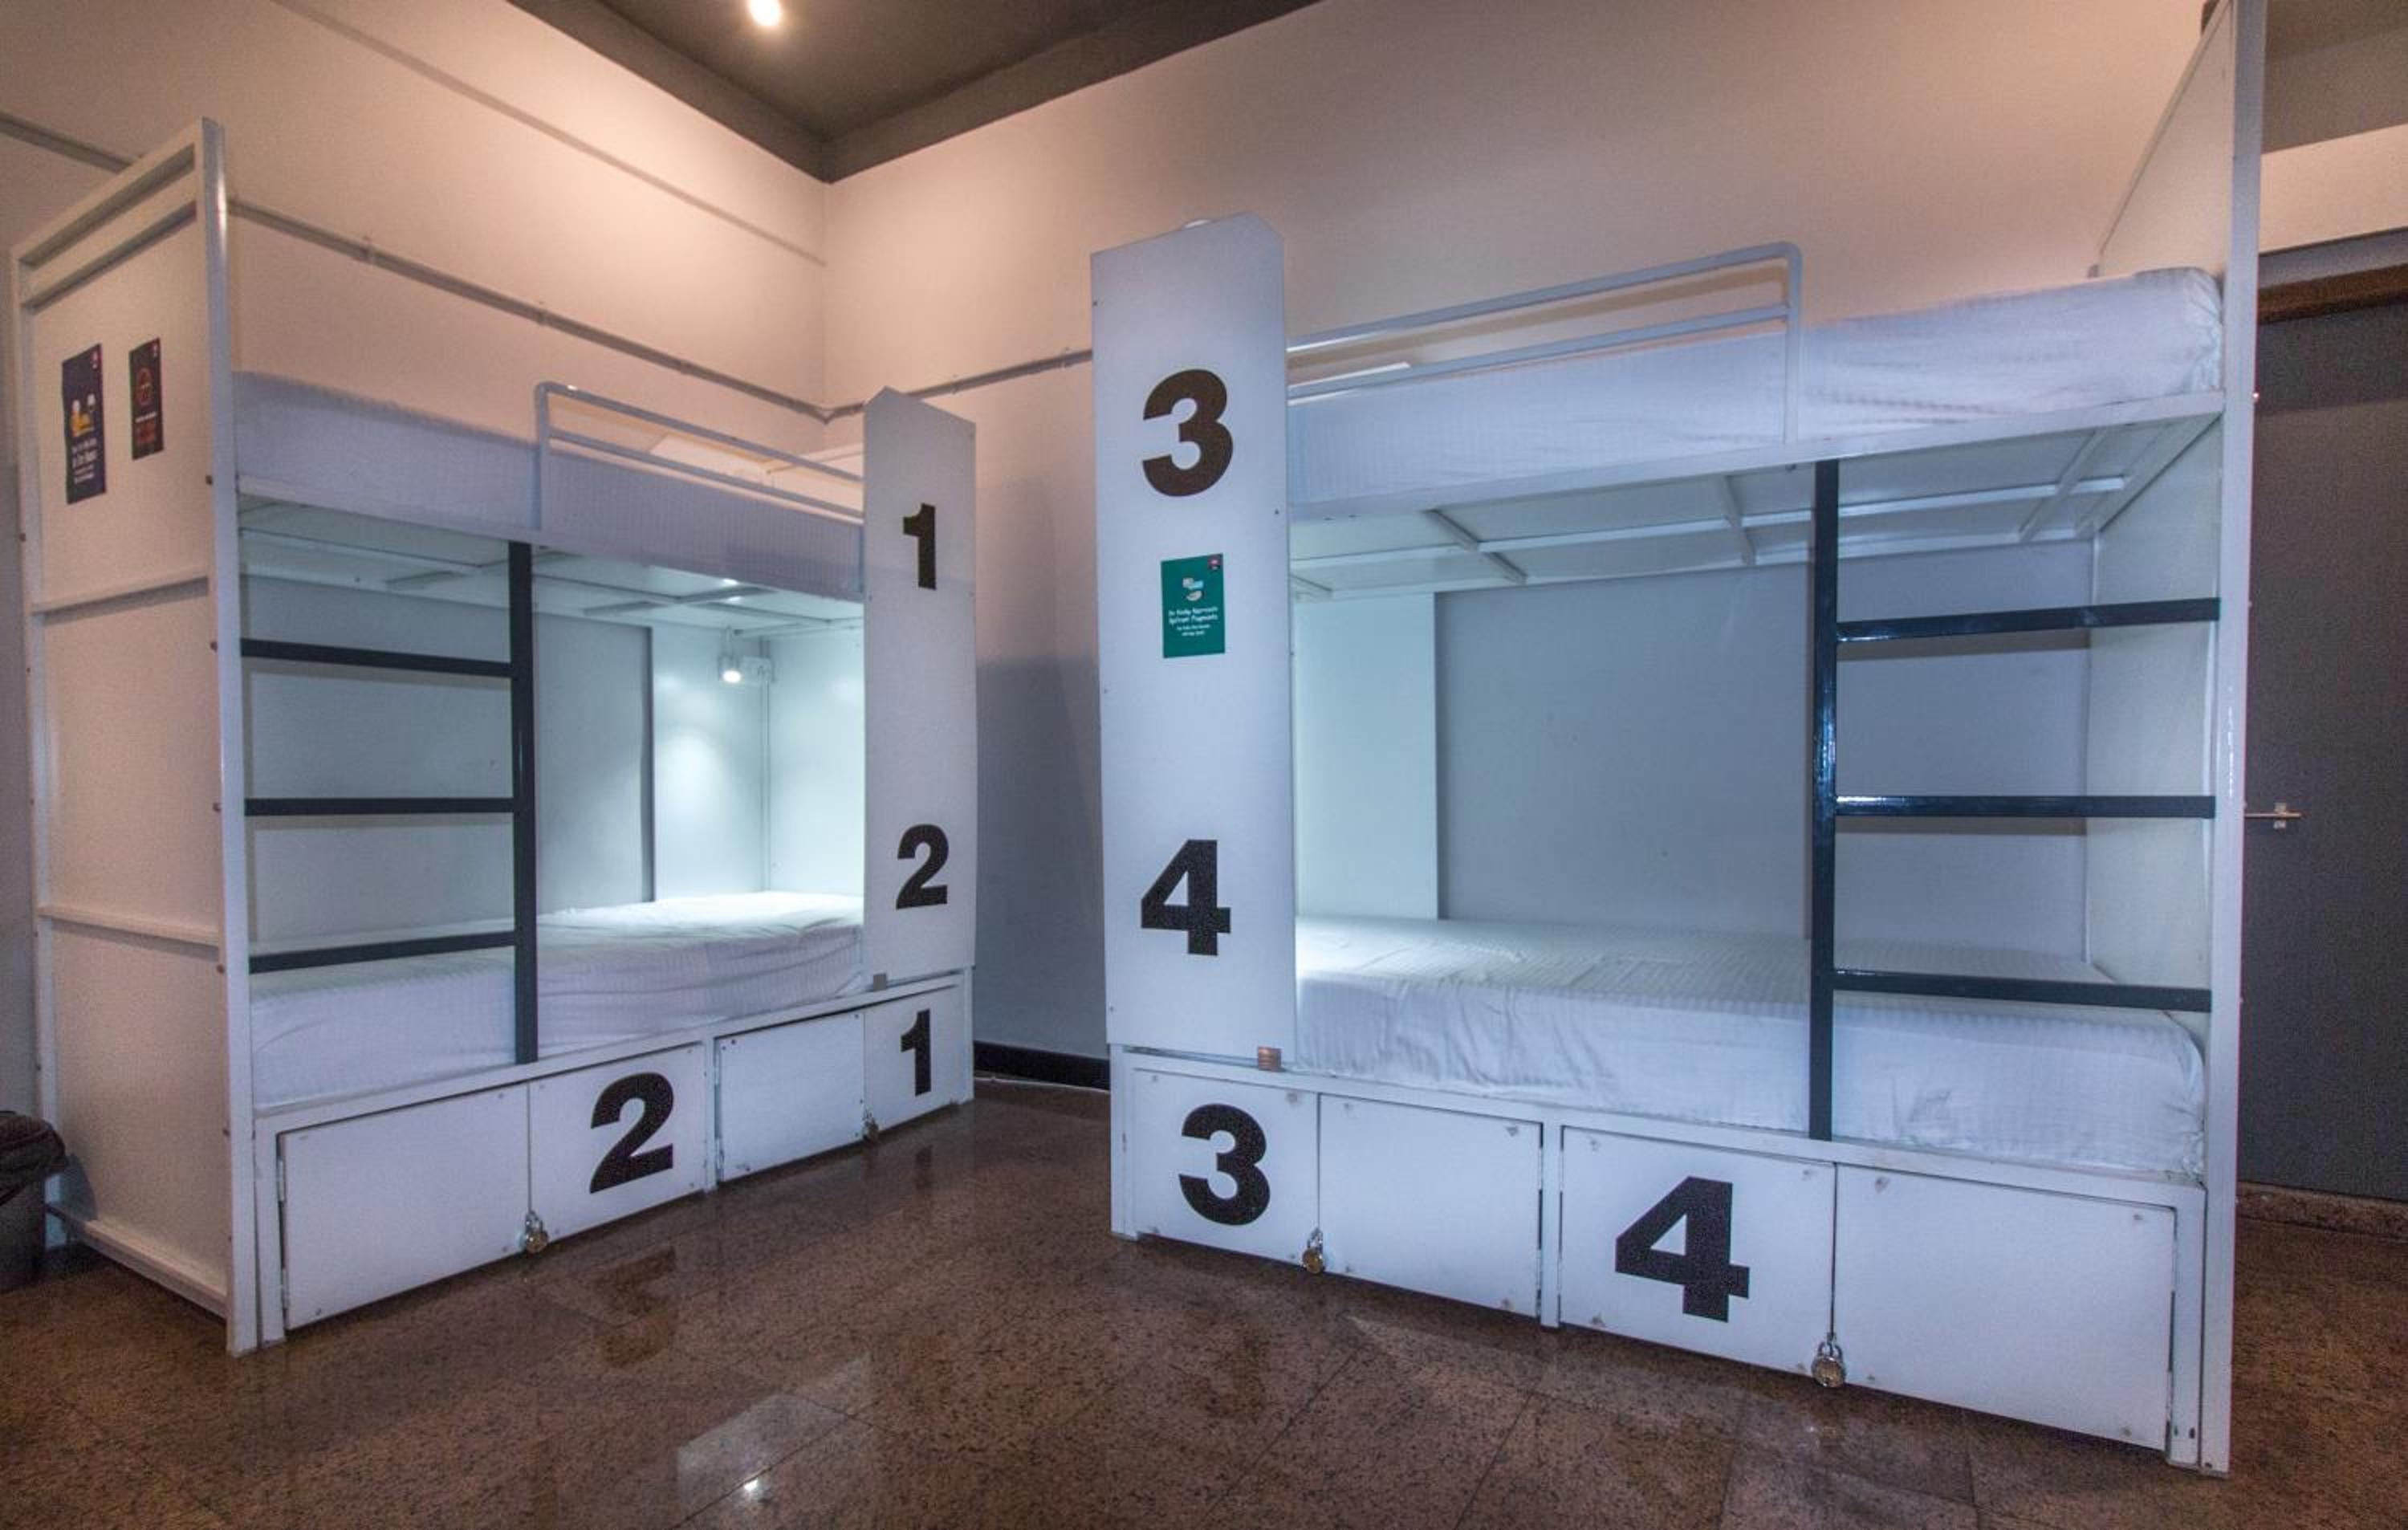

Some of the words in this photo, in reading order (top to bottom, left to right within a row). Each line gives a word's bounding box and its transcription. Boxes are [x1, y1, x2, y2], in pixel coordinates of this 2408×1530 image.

[1142, 369, 1233, 497] 3
[903, 503, 937, 590] 1
[896, 824, 950, 909] 2
[1141, 840, 1231, 956] 4
[901, 1008, 932, 1097] 1
[590, 1072, 674, 1194] 2
[1178, 1104, 1271, 1226] 3
[1615, 1176, 1750, 1323] 4
